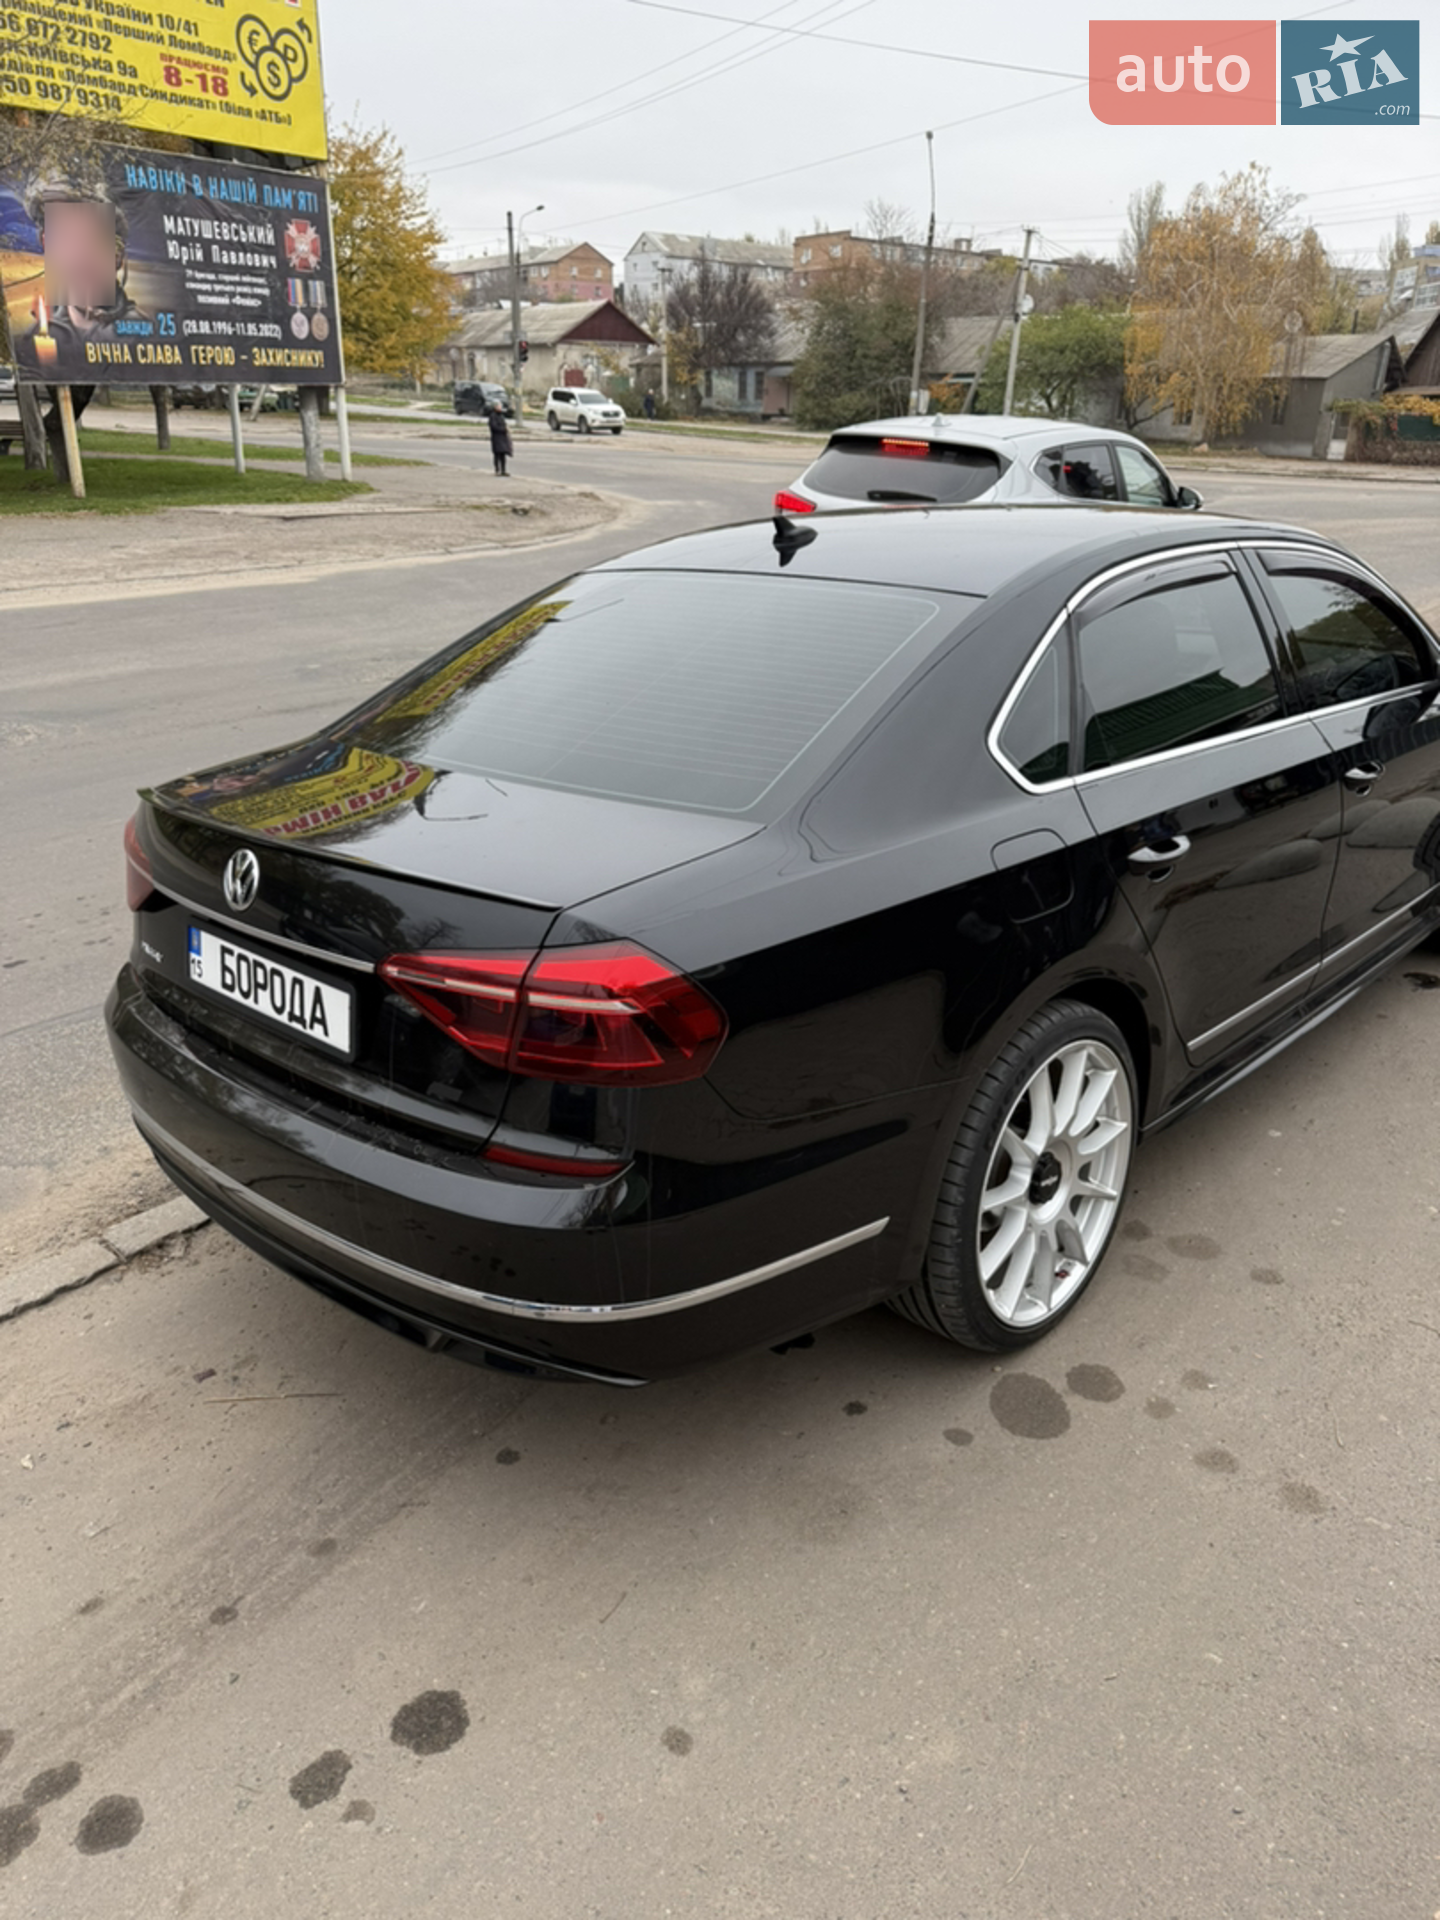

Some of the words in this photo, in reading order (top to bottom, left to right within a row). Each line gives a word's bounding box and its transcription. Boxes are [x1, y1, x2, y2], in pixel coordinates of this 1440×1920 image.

[65, 26, 113, 54] 2792
[156, 12, 199, 37] 10/41
[36, 80, 72, 103] 987
[76, 87, 123, 113] 9314
[163, 65, 229, 97] 8-18
[124, 164, 187, 195] НАВІКИ
[191, 174, 203, 198] В
[207, 177, 257, 204] НАШІЙ
[262, 184, 320, 213] ПАМ'ЯТІ
[163, 214, 276, 246] МАТУШЕВСЬКИЙ
[166, 239, 204, 266] Юрій
[211, 244, 278, 269] Павлович
[157, 312, 176, 337] 25
[85, 341, 133, 365] ВІЧНА
[136, 343, 183, 366] СЛАВА
[189, 345, 236, 366] ГЕРОЮ
[252, 347, 325, 368] ЗАХИСНИКУ!
[190, 957, 204, 979] 15
[220, 944, 329, 1038] БОРОДА
